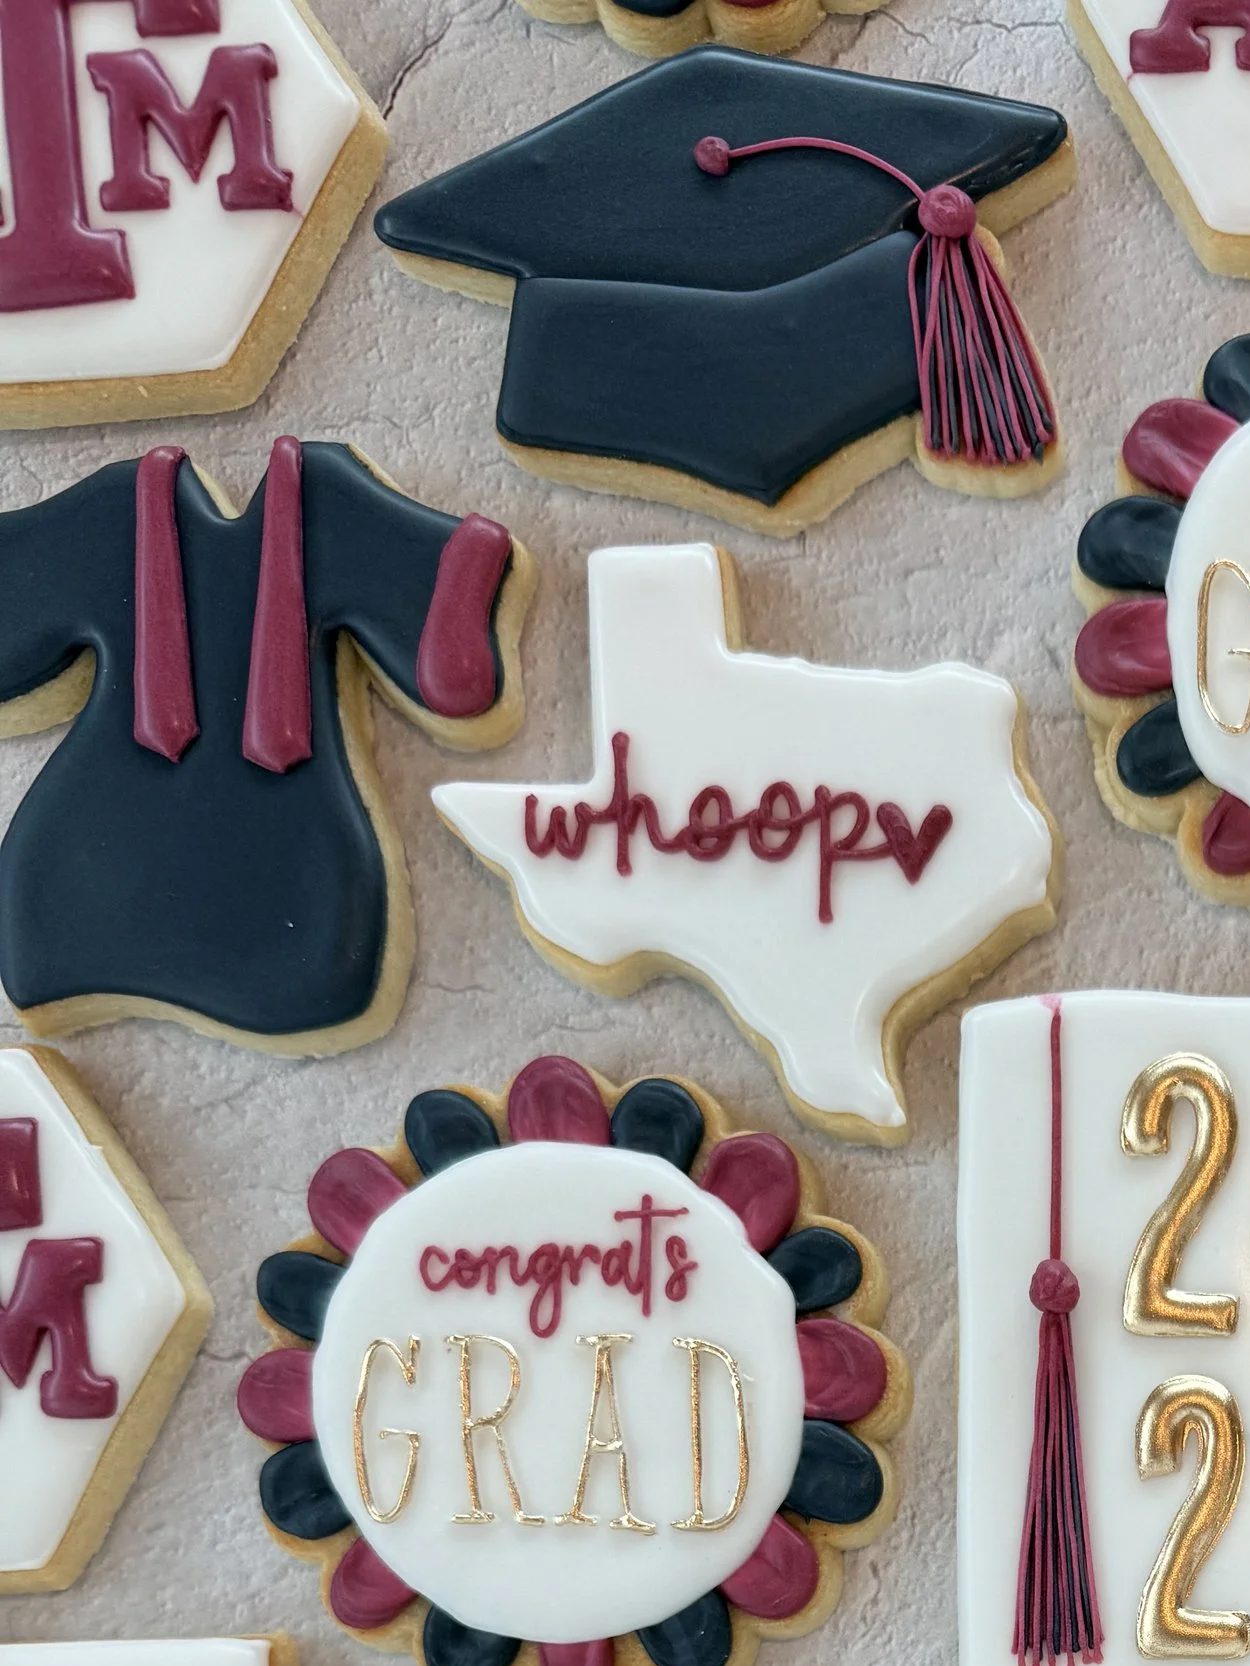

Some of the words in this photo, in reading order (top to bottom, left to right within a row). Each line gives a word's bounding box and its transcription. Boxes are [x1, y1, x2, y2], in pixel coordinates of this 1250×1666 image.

[524, 731, 880, 925] whoop
[418, 1193, 699, 1340] congrats
[352, 1333, 757, 1537] GRAD
